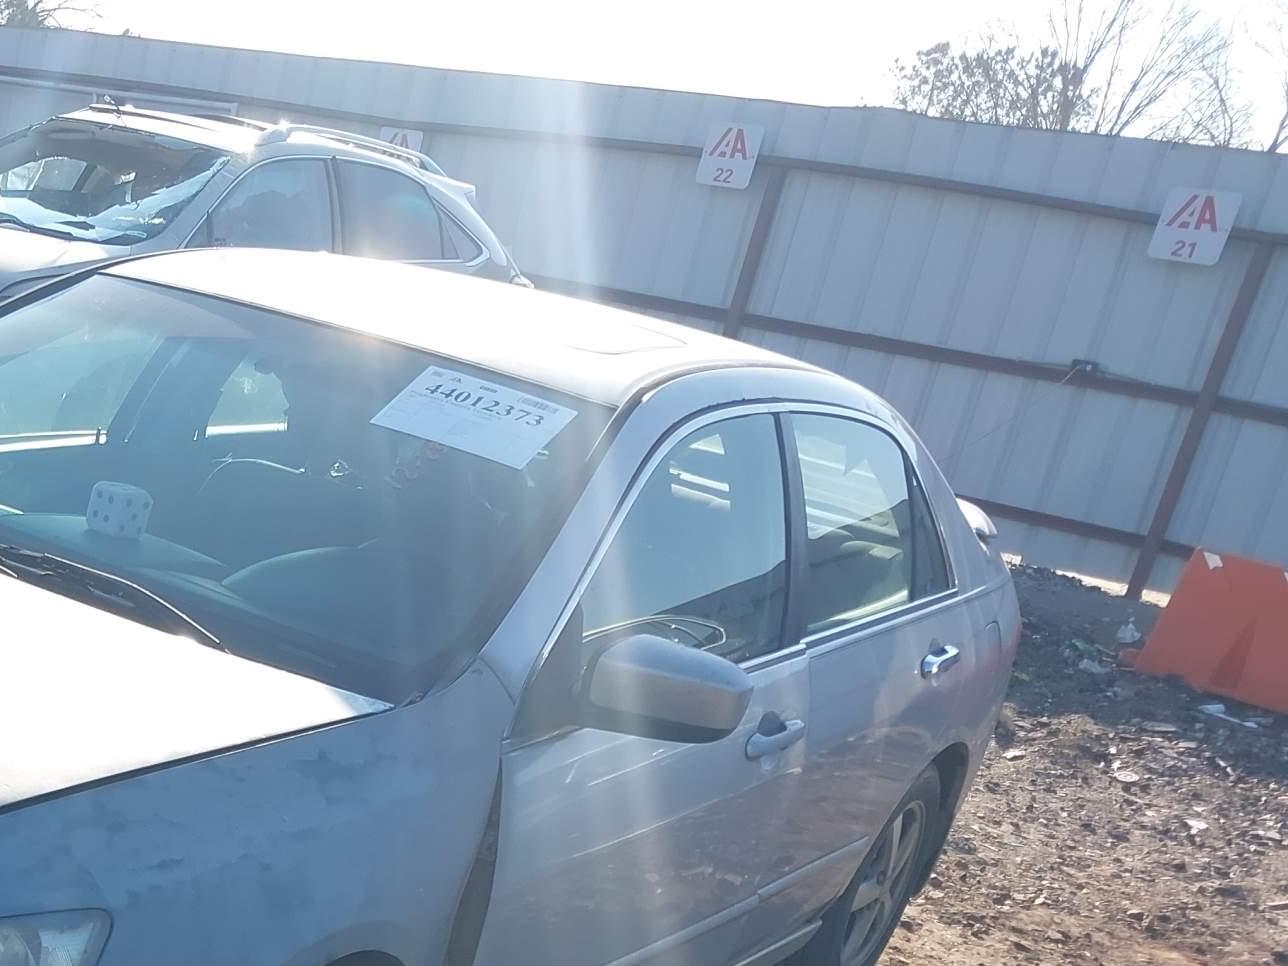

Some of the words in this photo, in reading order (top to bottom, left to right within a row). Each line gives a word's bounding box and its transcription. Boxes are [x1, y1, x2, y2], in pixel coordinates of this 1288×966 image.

[713, 167, 733, 184] 22
[1170, 240, 1197, 258] 21
[425, 384, 544, 426] 44012373
